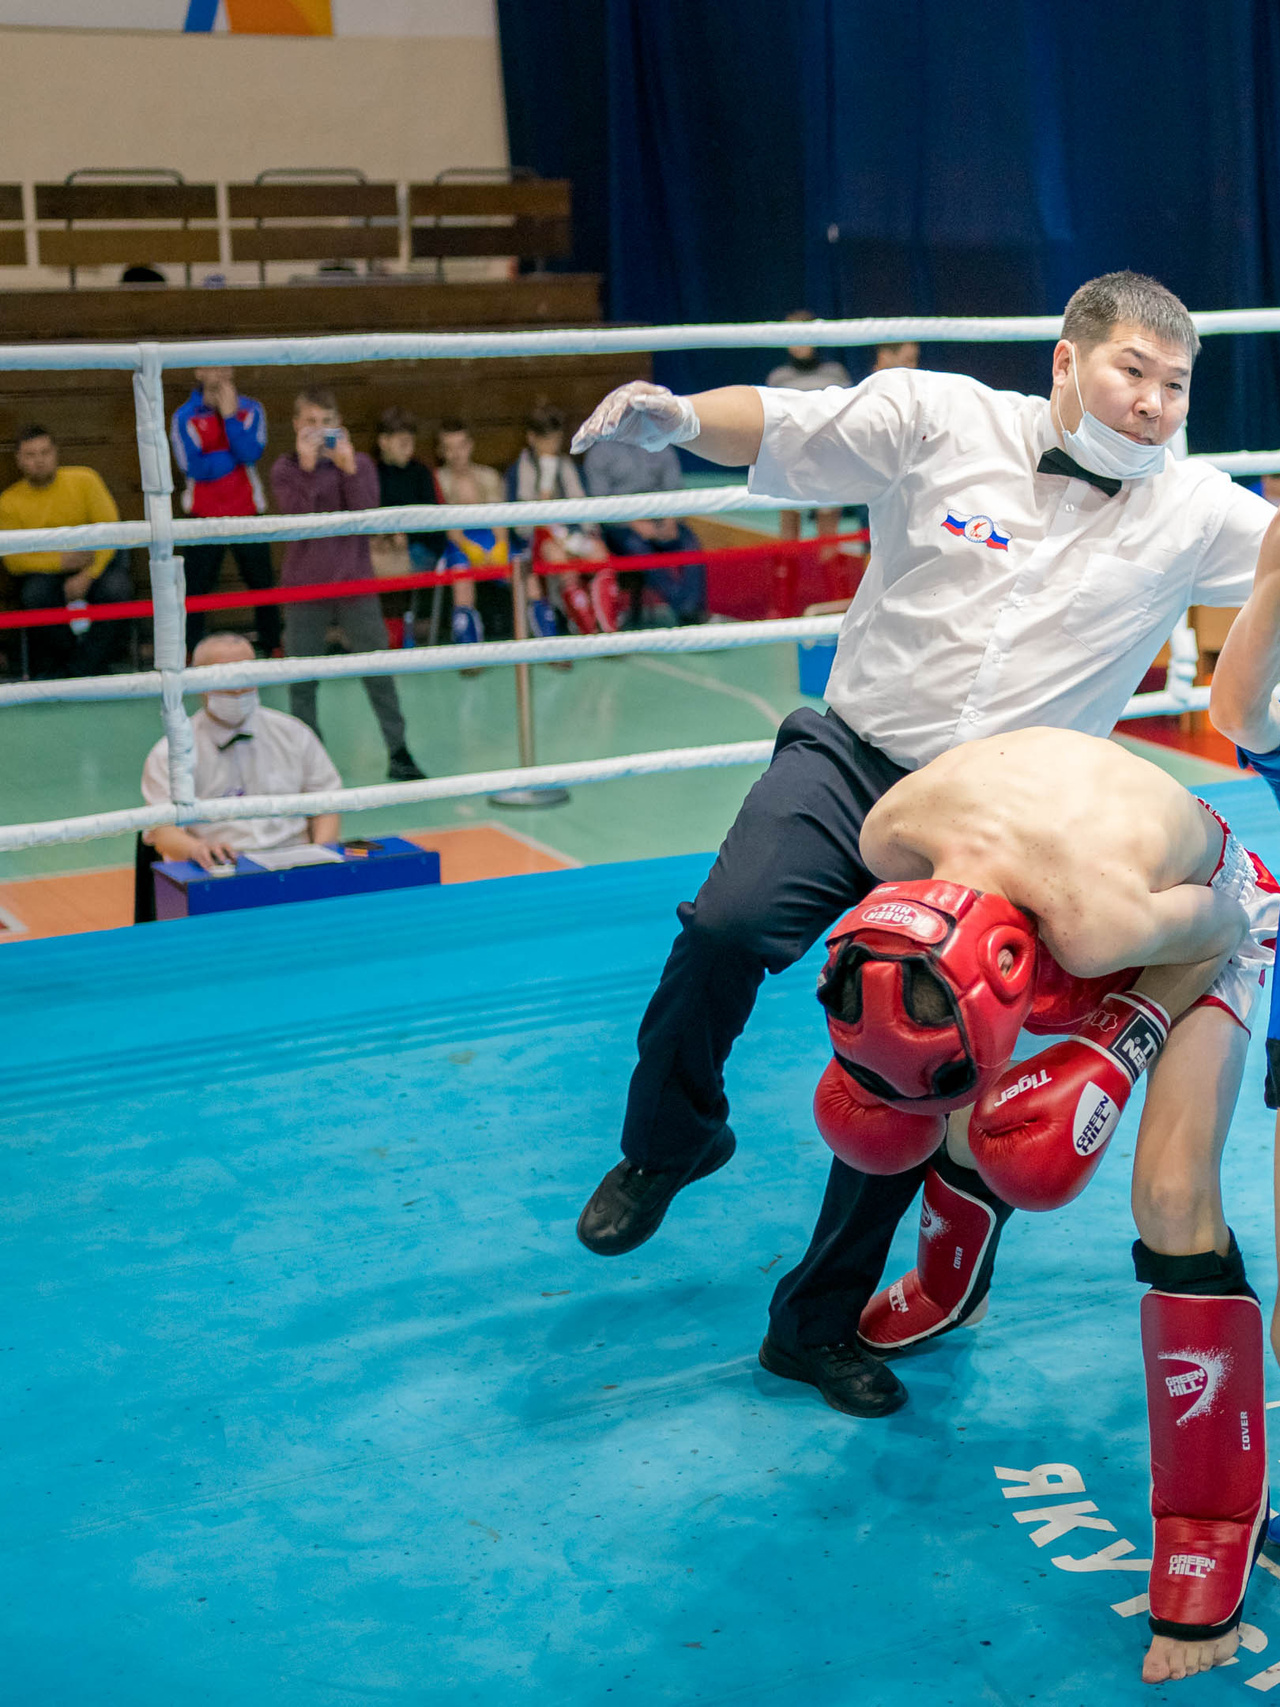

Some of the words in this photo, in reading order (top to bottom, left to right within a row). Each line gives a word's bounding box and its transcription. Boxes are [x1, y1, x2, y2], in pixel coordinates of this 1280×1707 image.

[867, 911, 914, 925] GREEN
[881, 904, 912, 915] HILL
[994, 1069, 1052, 1107] Tiger
[1076, 1095, 1110, 1149] GREEN
[1081, 1112, 1111, 1153] HILL
[1165, 1368, 1206, 1387] GREEN
[1168, 1380, 1203, 1397] HILL
[1240, 1411, 1251, 1451] COVER
[1168, 1562, 1207, 1579] HILL
[1169, 1554, 1216, 1569] GREEN
